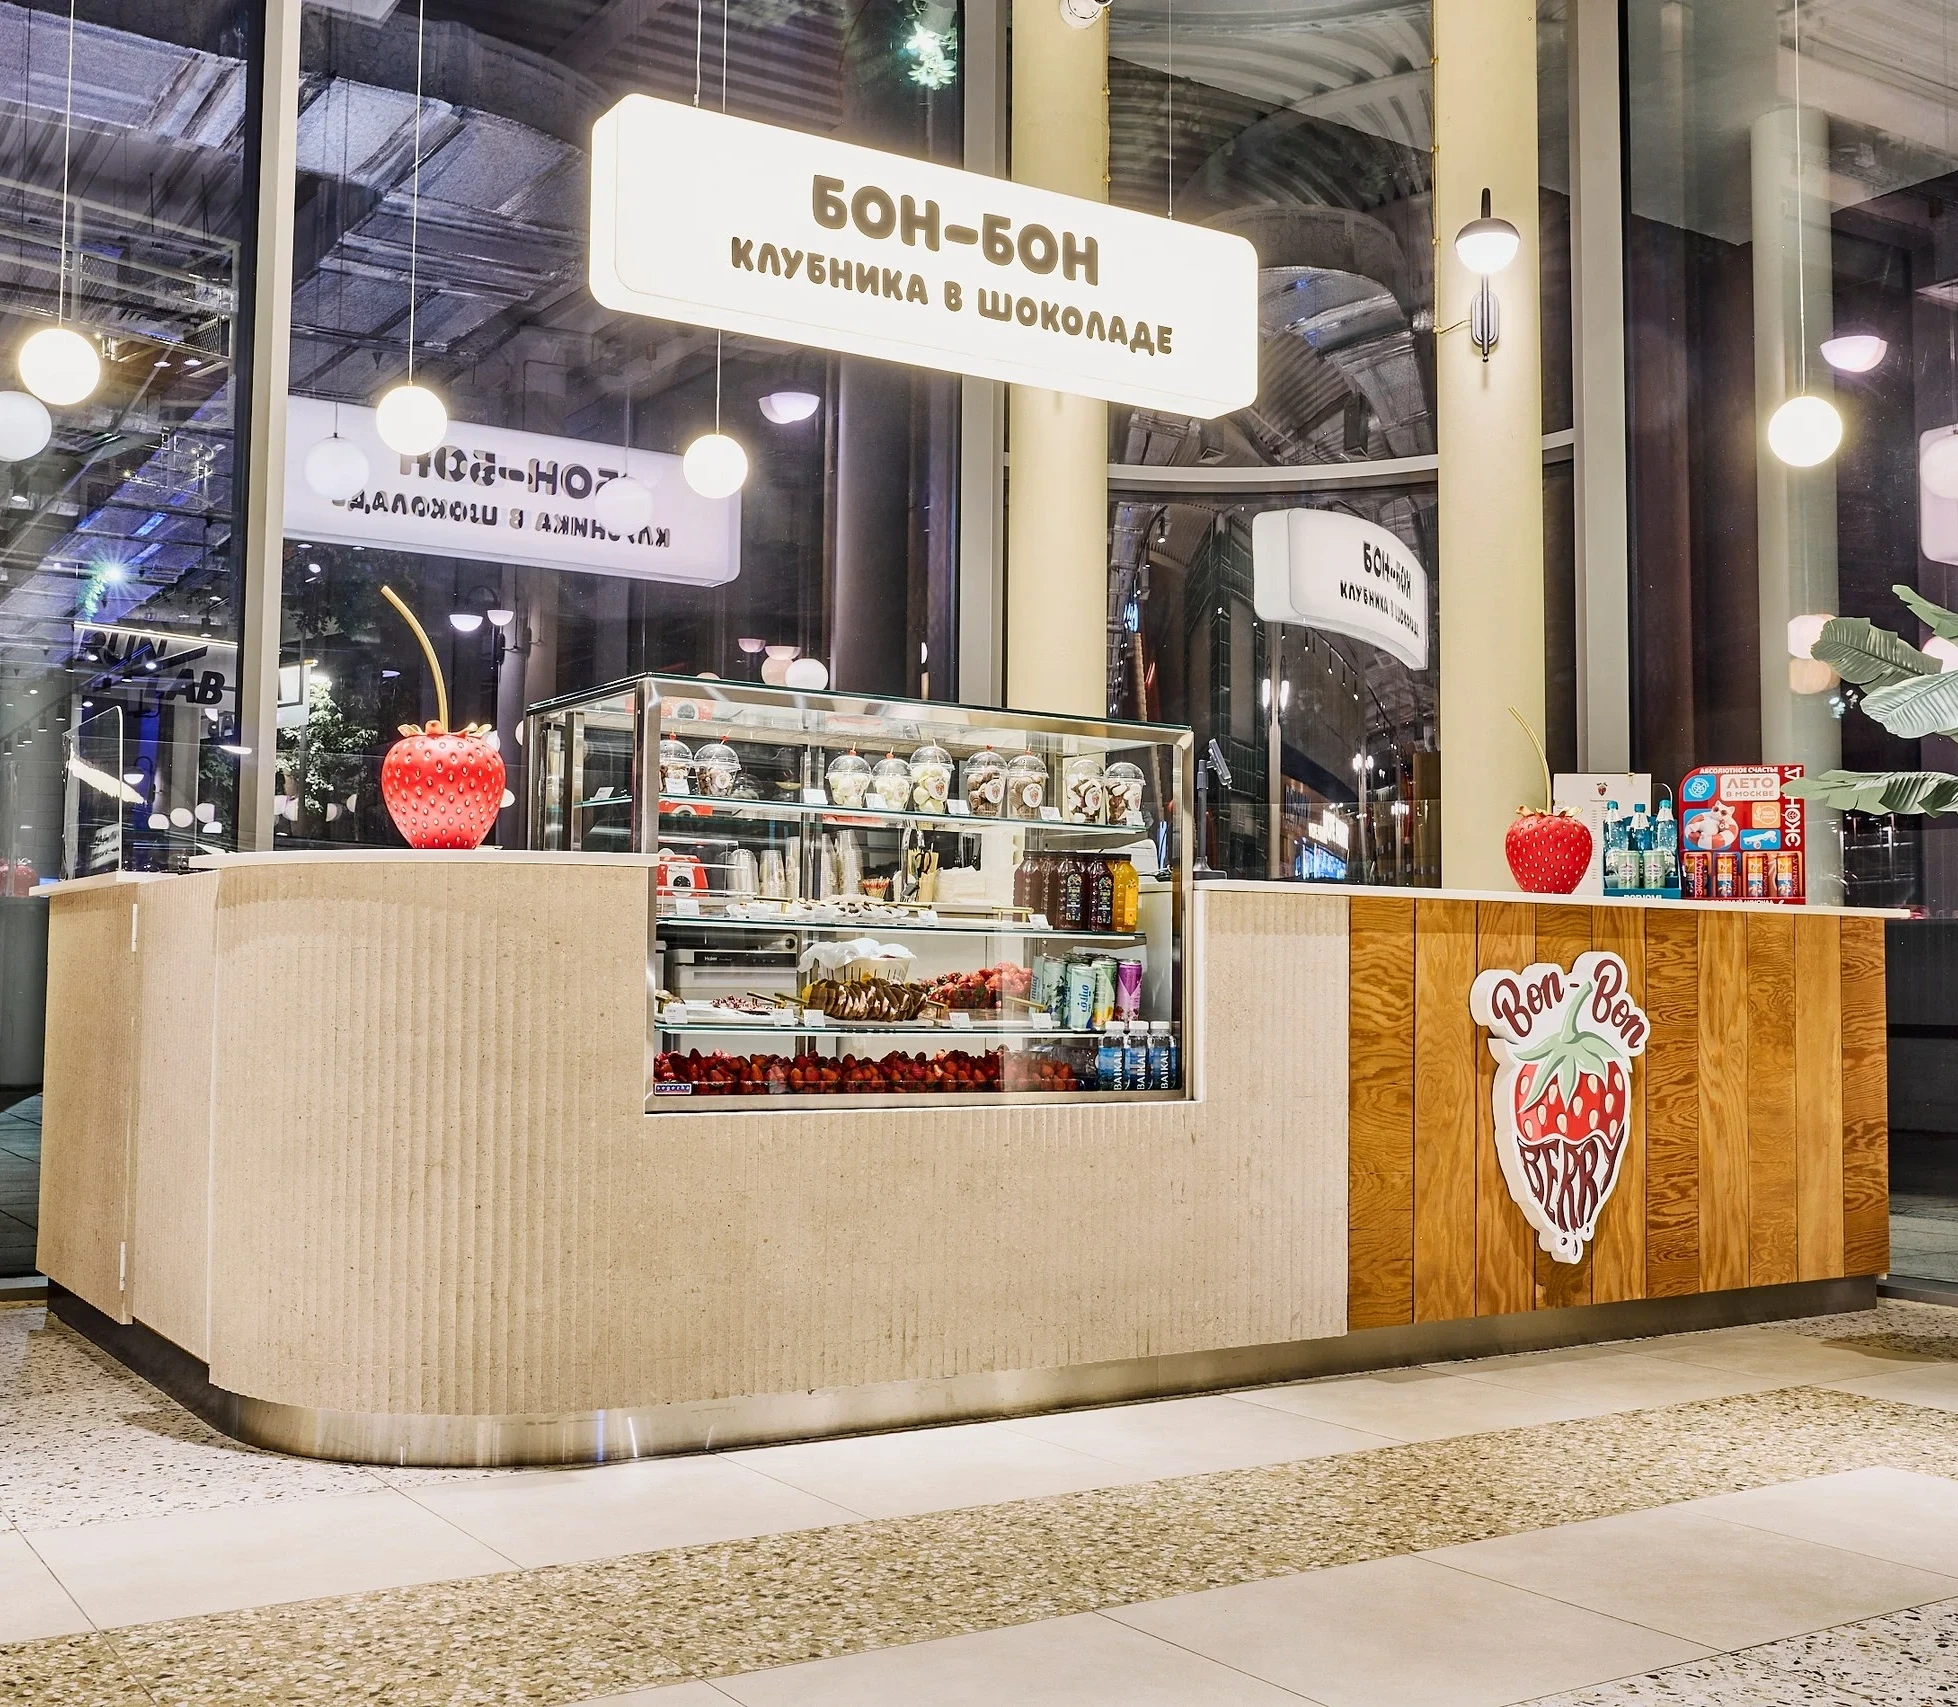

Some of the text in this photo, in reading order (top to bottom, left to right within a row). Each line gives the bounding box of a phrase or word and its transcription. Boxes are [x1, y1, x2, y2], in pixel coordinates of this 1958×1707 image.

[812, 174, 1100, 286] БОН-БОН
[730, 236, 1173, 357] КЛУБНИКА В ШОКОЛАДЕ
[1726, 777, 1774, 789] ЛЕТО
[1726, 790, 1774, 798] В МОСКВЕ
[1782, 766, 1802, 847] ЭКОНД
[1113, 1050, 1123, 1091] BAIKAL
[1136, 1049, 1146, 1090] BAIKAL
[1160, 1050, 1169, 1089] BAIKAL
[1517, 1123, 1625, 1233] BERRY
